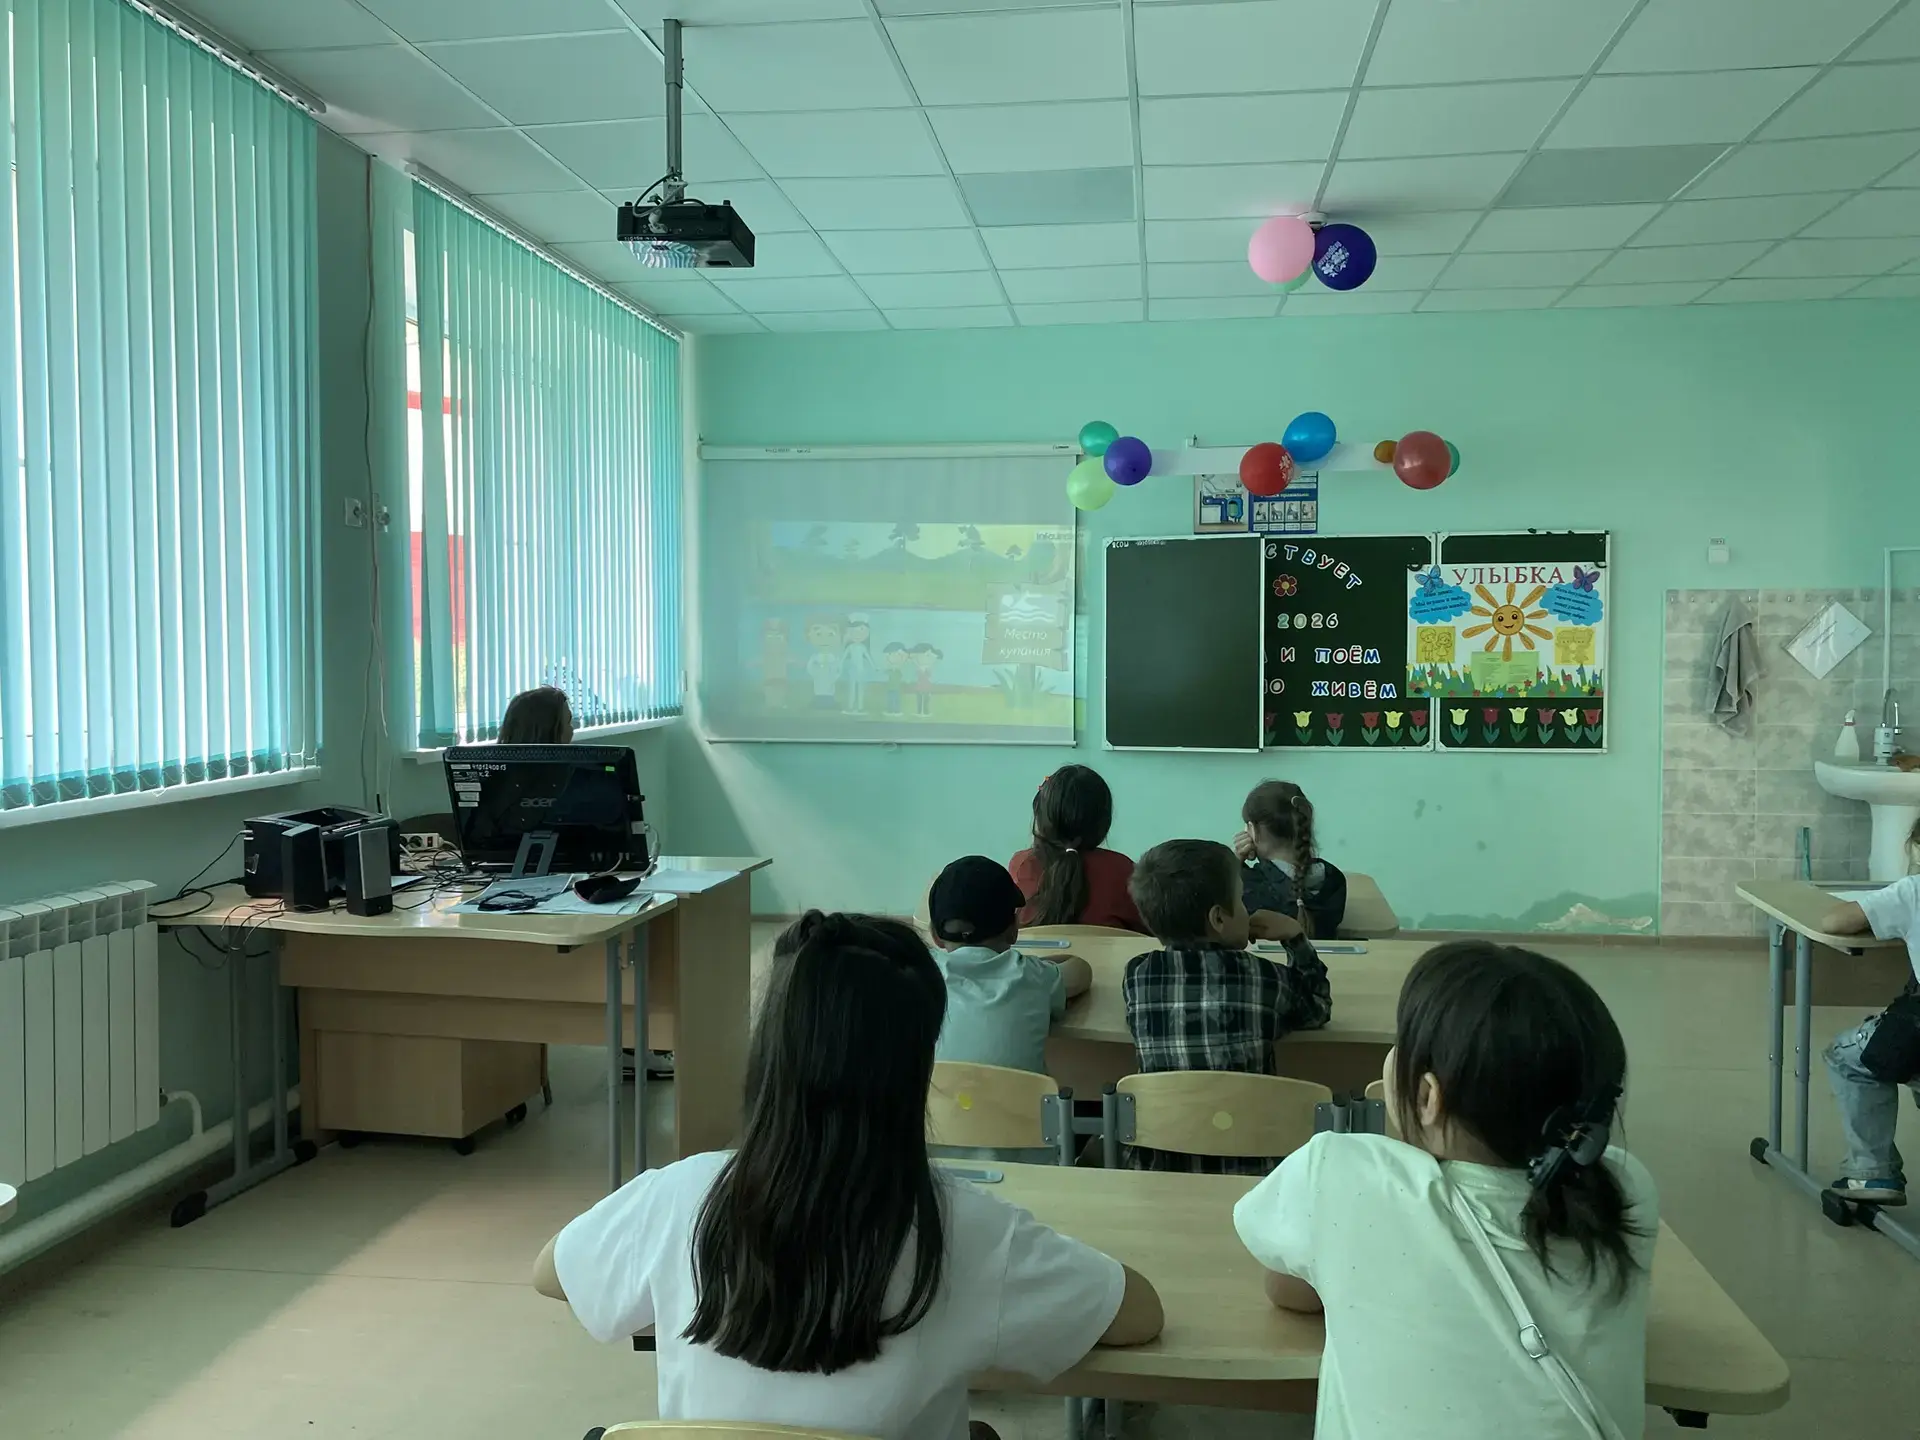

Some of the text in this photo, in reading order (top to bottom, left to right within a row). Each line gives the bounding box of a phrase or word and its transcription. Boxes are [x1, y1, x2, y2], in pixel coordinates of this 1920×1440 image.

[1452, 566, 1565, 586] УЛЫБКА
[1277, 612, 1339, 629] 2026
[1004, 628, 1048, 640] Место
[999, 647, 1052, 659] купания
[1281, 646, 1296, 663] И
[1315, 645, 1381, 664] ПОЁМ
[1311, 680, 1397, 699] ЖИВЁМ
[520, 798, 558, 807] acer
